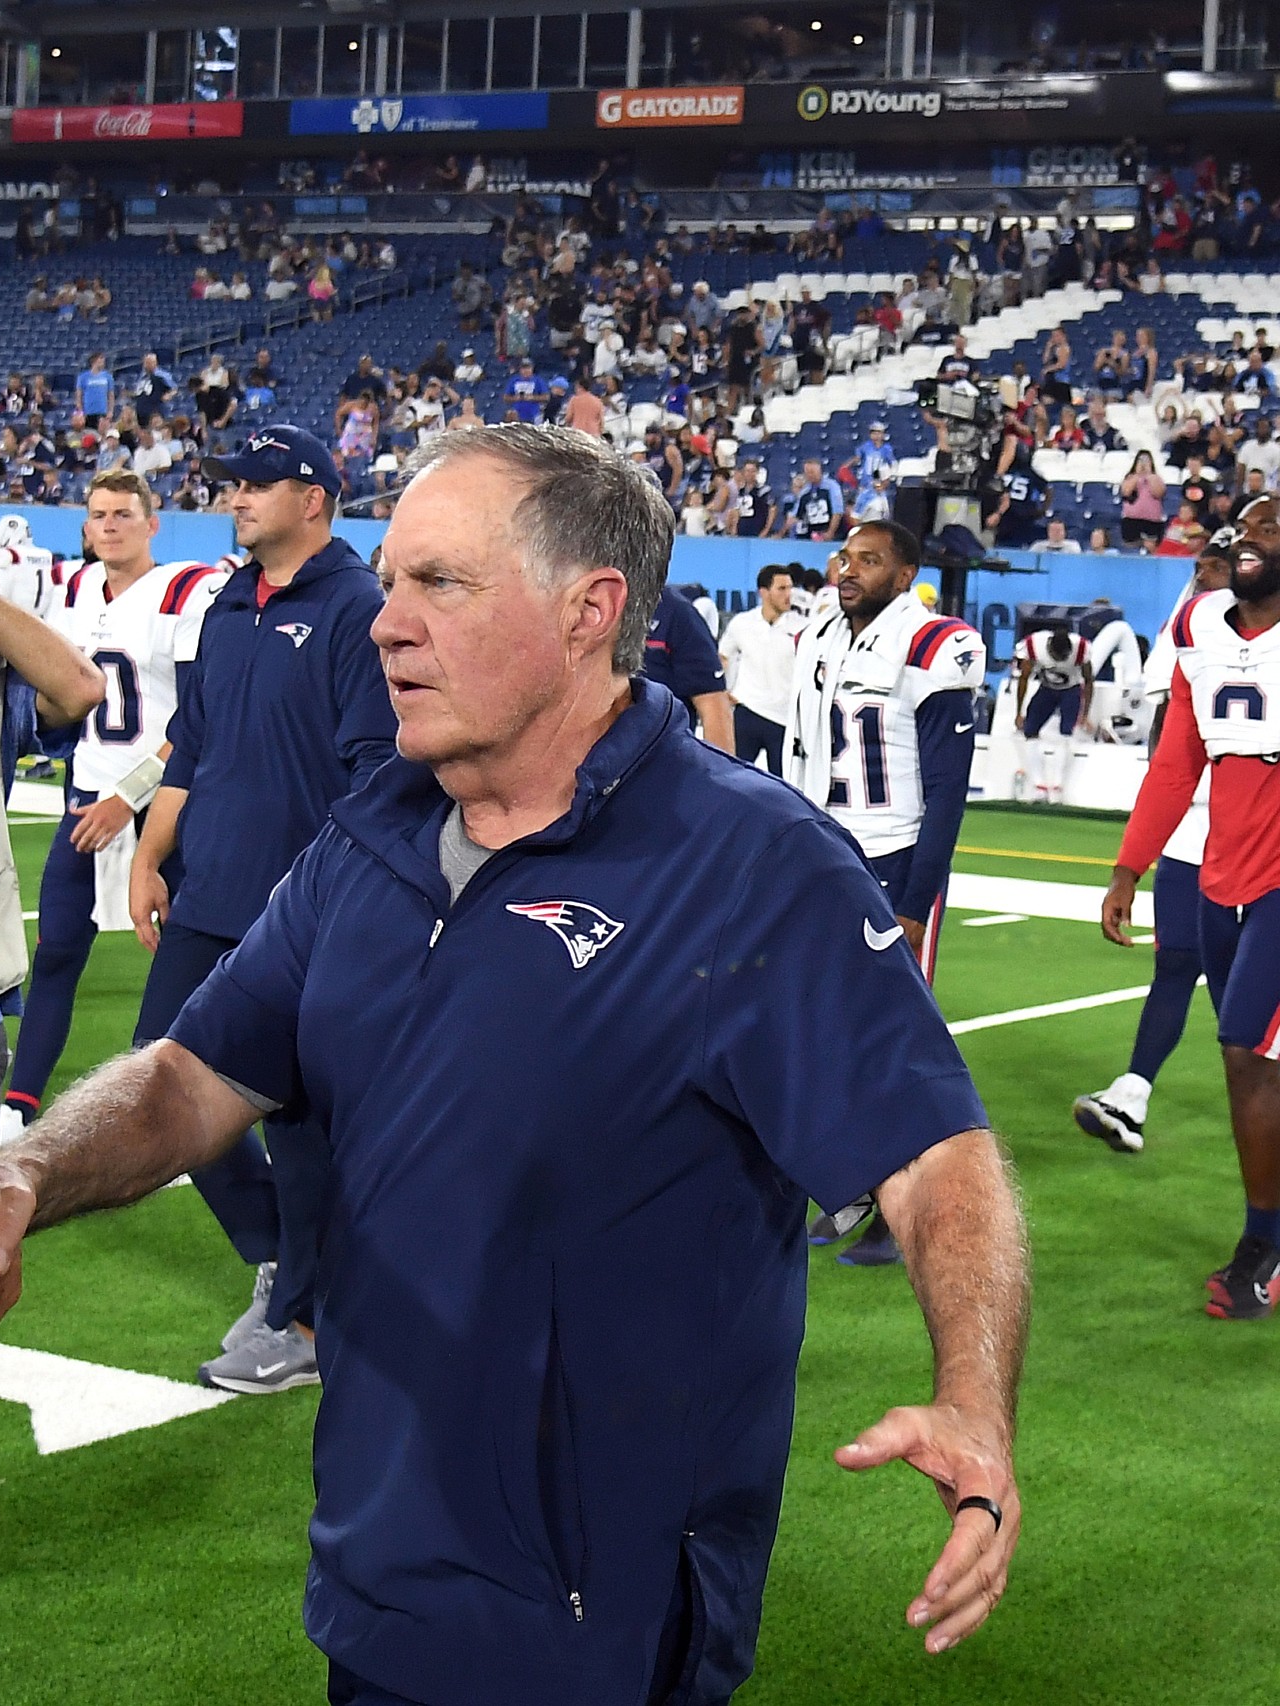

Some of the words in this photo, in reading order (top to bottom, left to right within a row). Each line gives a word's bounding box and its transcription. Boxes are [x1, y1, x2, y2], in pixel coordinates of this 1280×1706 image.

[601, 95, 622, 123] G
[627, 95, 738, 118] GATORADE
[831, 90, 941, 117] RJYoung
[35, 569, 43, 608] 1
